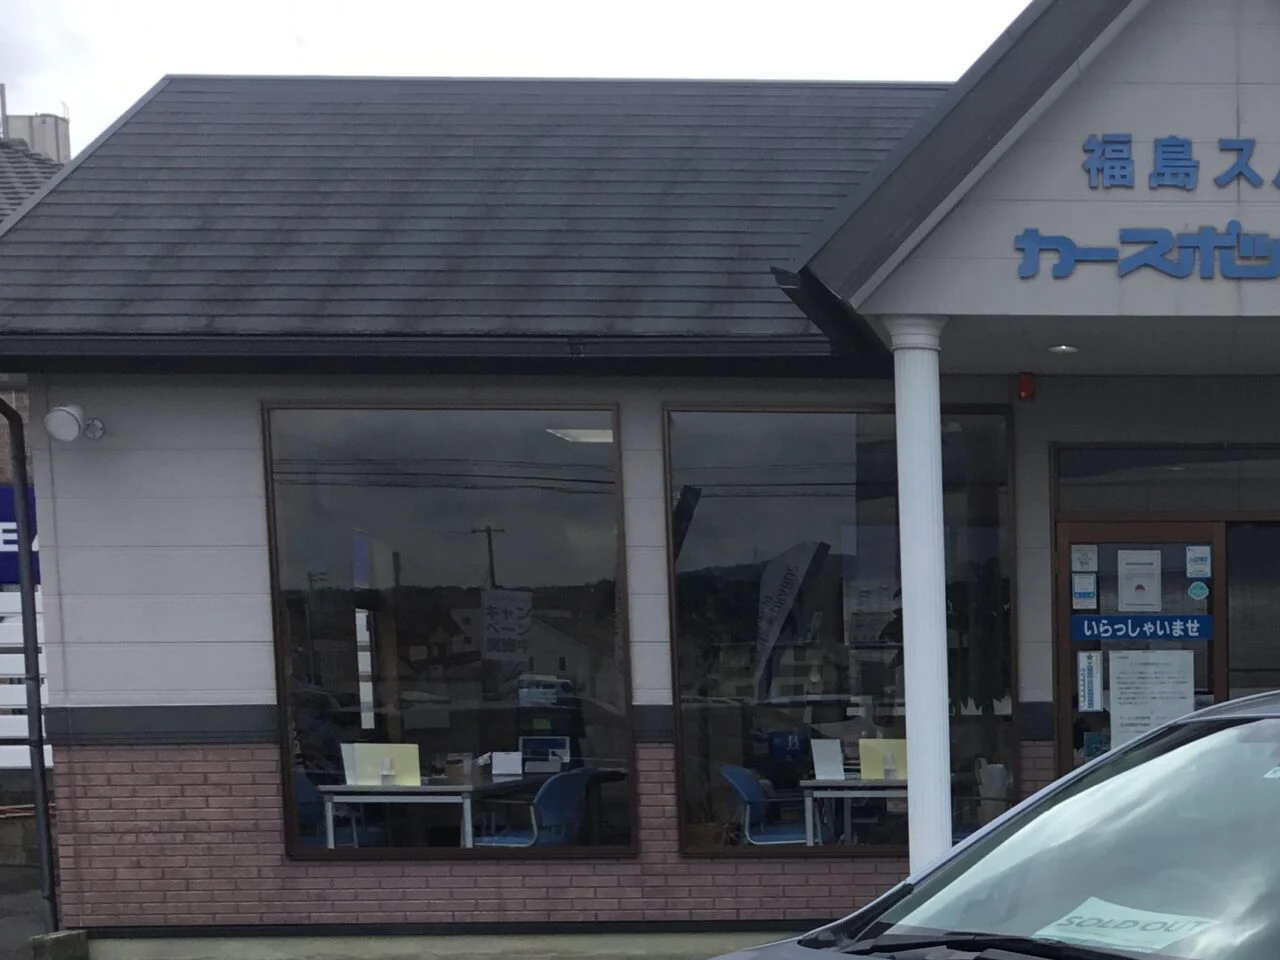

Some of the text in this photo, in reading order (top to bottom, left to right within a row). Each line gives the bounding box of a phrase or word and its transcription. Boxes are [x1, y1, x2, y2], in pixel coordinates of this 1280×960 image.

[1084, 619, 1200, 637] いらっしゃいませ
[1056, 916, 1210, 932] SOLD OUT
